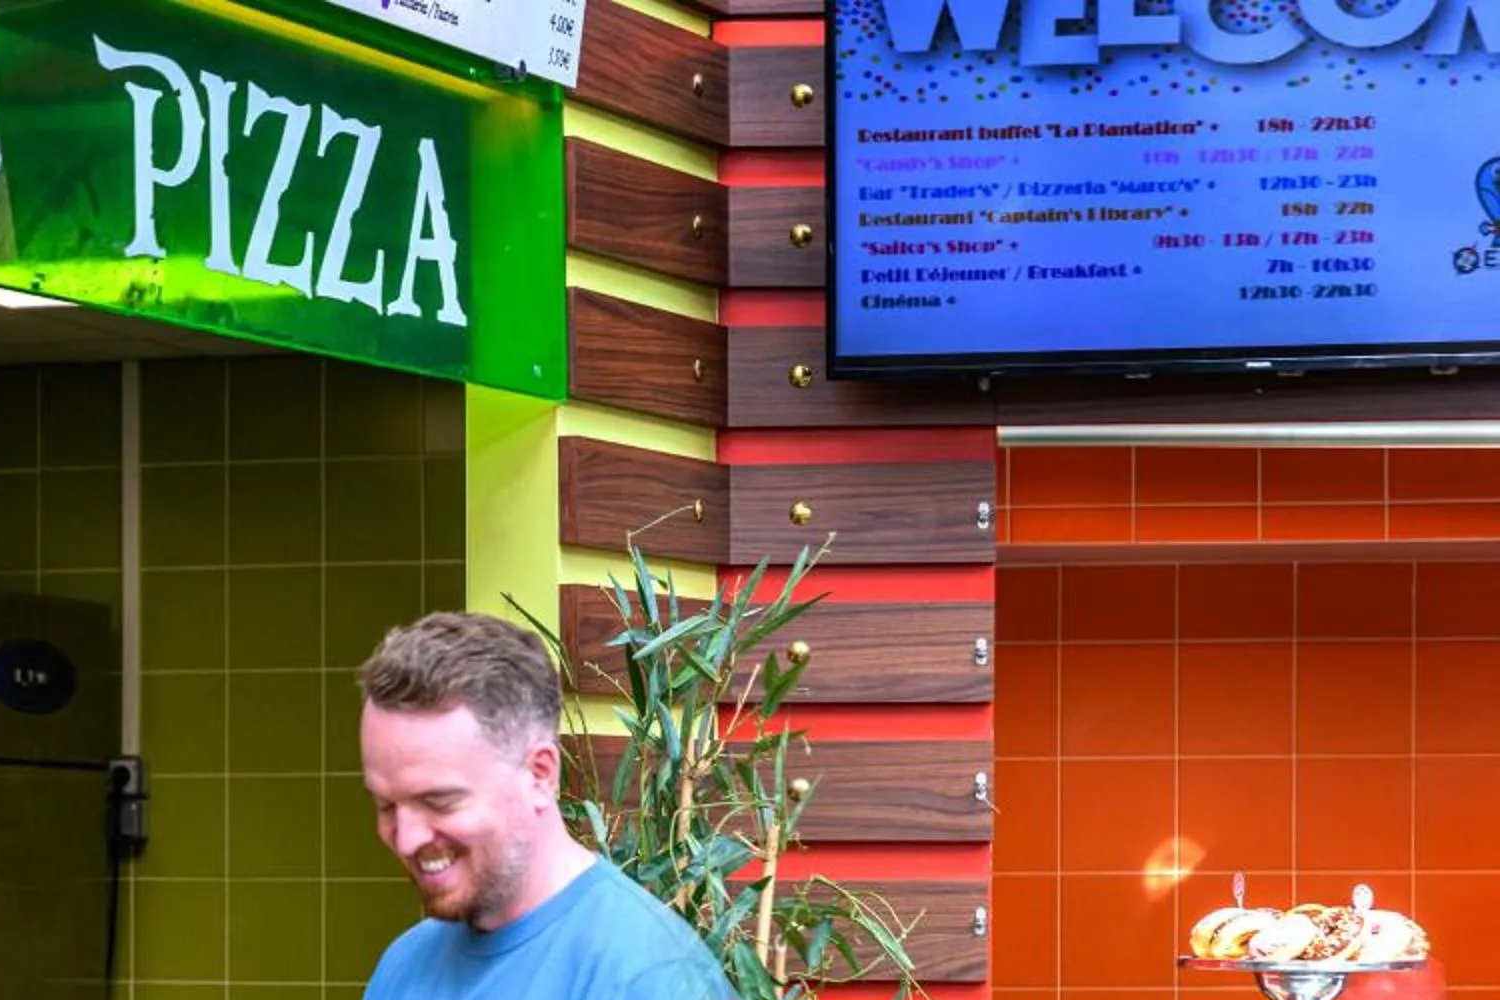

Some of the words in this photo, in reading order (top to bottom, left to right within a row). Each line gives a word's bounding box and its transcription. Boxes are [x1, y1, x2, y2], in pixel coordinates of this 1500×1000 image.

[857, 126, 973, 144] Restaurant
[979, 124, 1041, 141] buffet
[1257, 117, 1295, 133] 18h
[1309, 115, 1377, 132] 22h30
[93, 34, 467, 326] PIZZA
[858, 185, 894, 201] Bar
[1018, 179, 1107, 197] Pizzeria
[1260, 175, 1323, 191] 12h30
[1337, 173, 1378, 189] 23h
[859, 210, 974, 228] Restaurant
[1281, 201, 1319, 217] 18h
[1336, 199, 1375, 216] 22h
[1334, 228, 1375, 245] 23h
[861, 267, 911, 285] Petit
[916, 265, 1006, 284] Déjeuner
[1027, 262, 1128, 281] Breakfast
[1266, 258, 1295, 275] 7h
[1311, 256, 1376, 273] 10h30
[861, 293, 942, 310] Cinéma
[1238, 284, 1303, 301] 12h30
